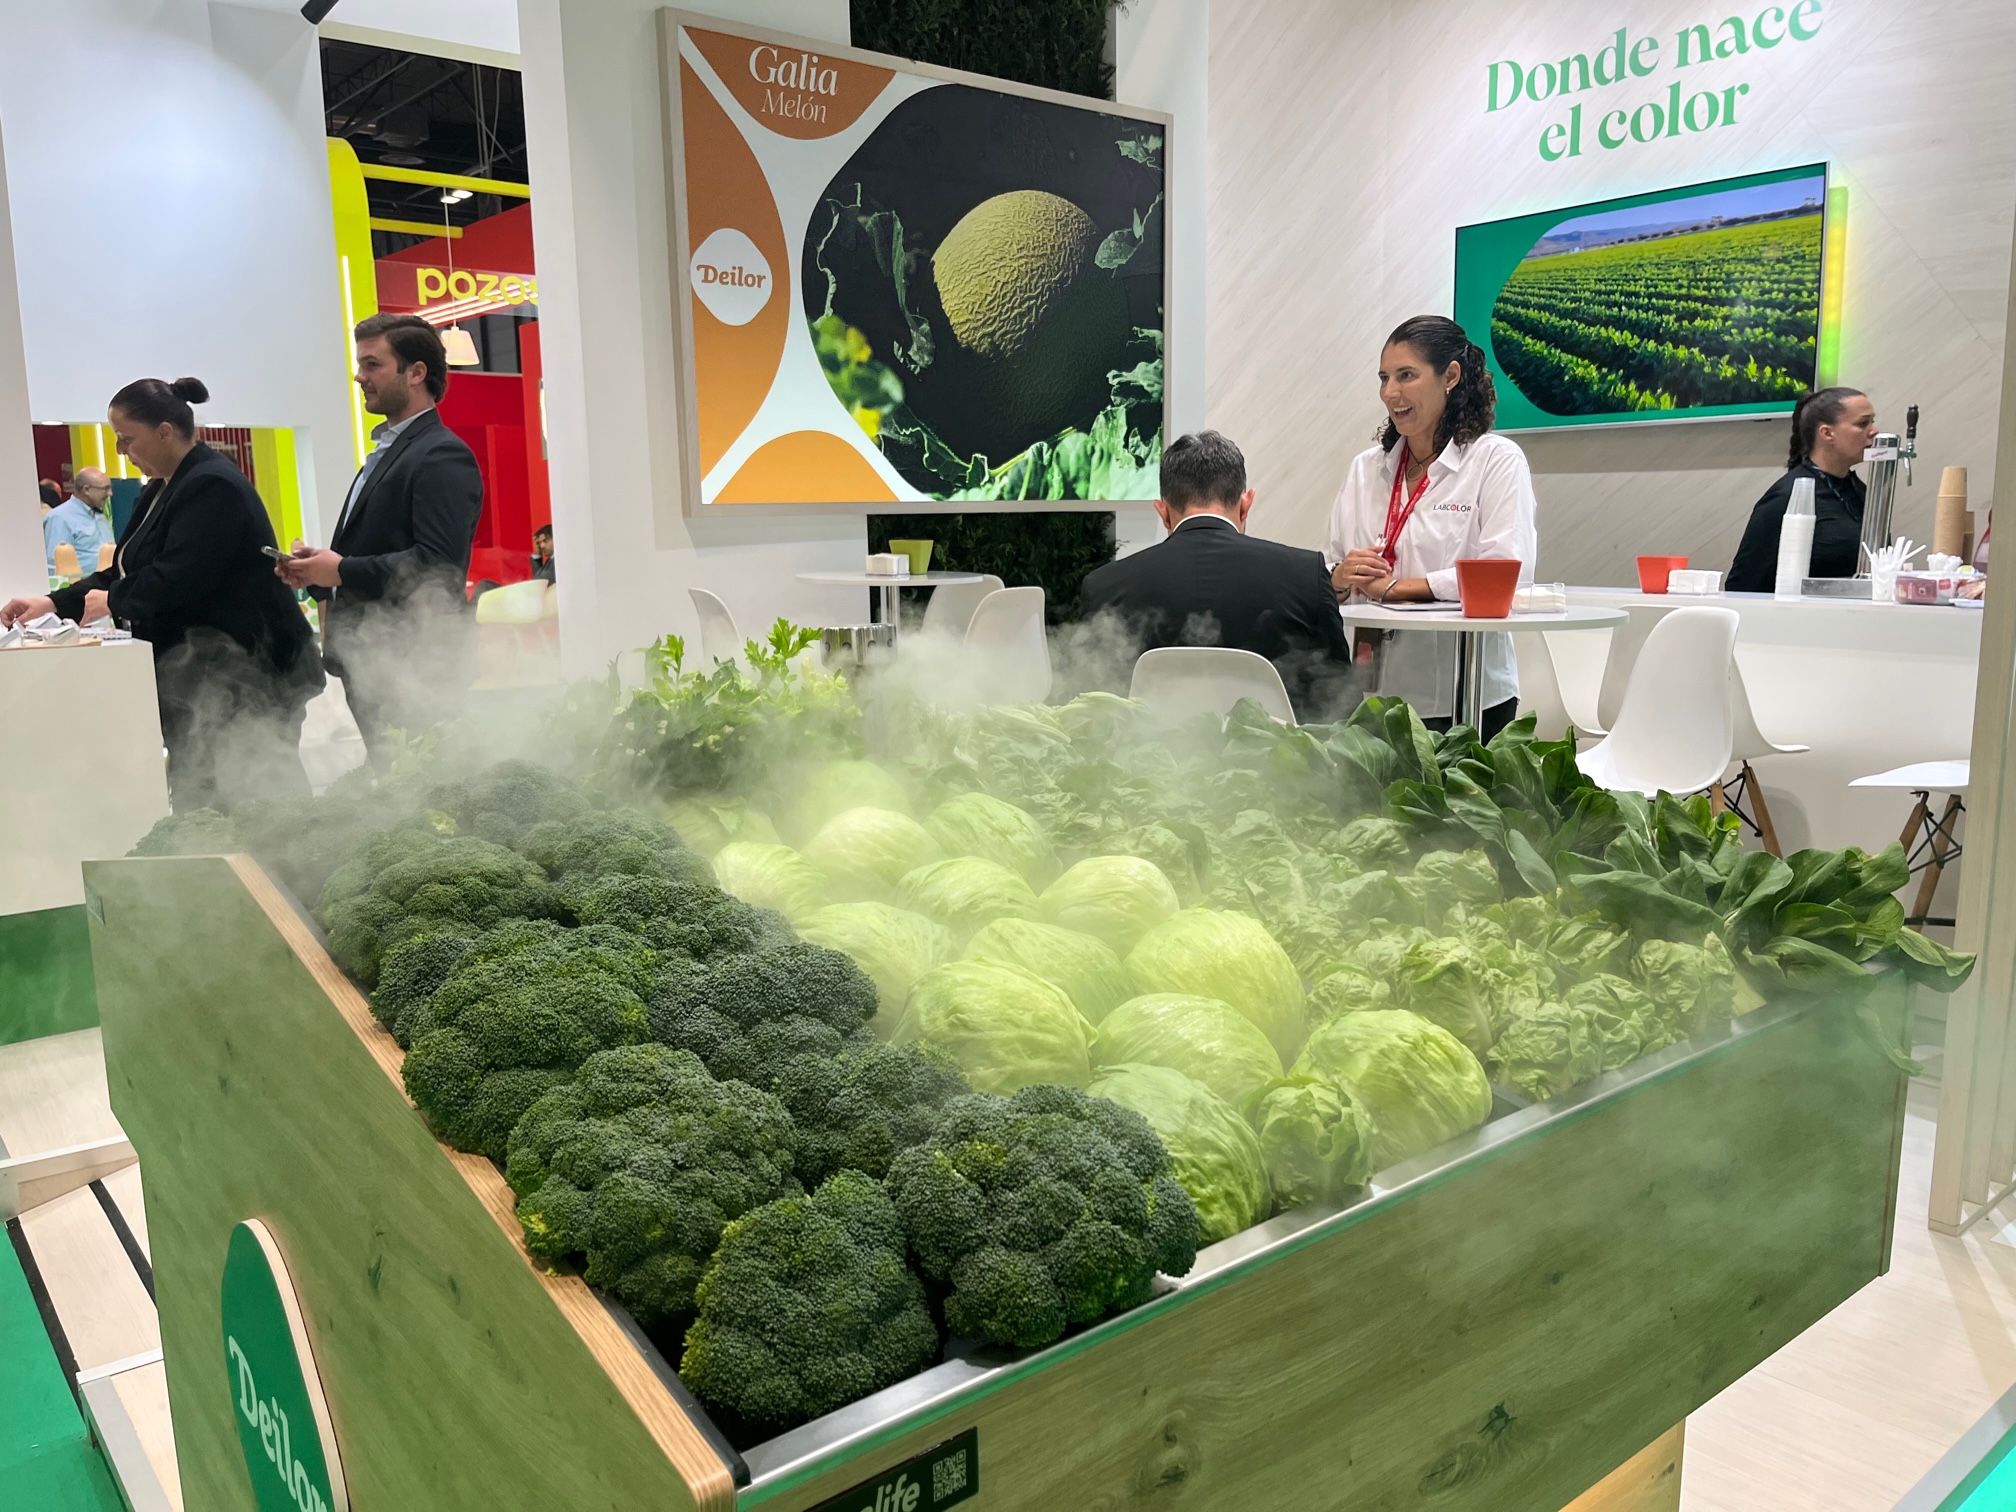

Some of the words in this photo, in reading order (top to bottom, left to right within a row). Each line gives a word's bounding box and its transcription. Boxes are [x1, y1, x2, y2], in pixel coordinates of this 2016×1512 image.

[748, 46, 838, 96] Galia
[1484, 26, 1660, 113] Donde
[1674, 0, 1823, 69] nace
[761, 88, 827, 124] Melón
[1538, 103, 1583, 162] el
[1598, 80, 1750, 150] color
[696, 264, 767, 289] Deilor
[1433, 503, 1472, 513] LABCOLOR
